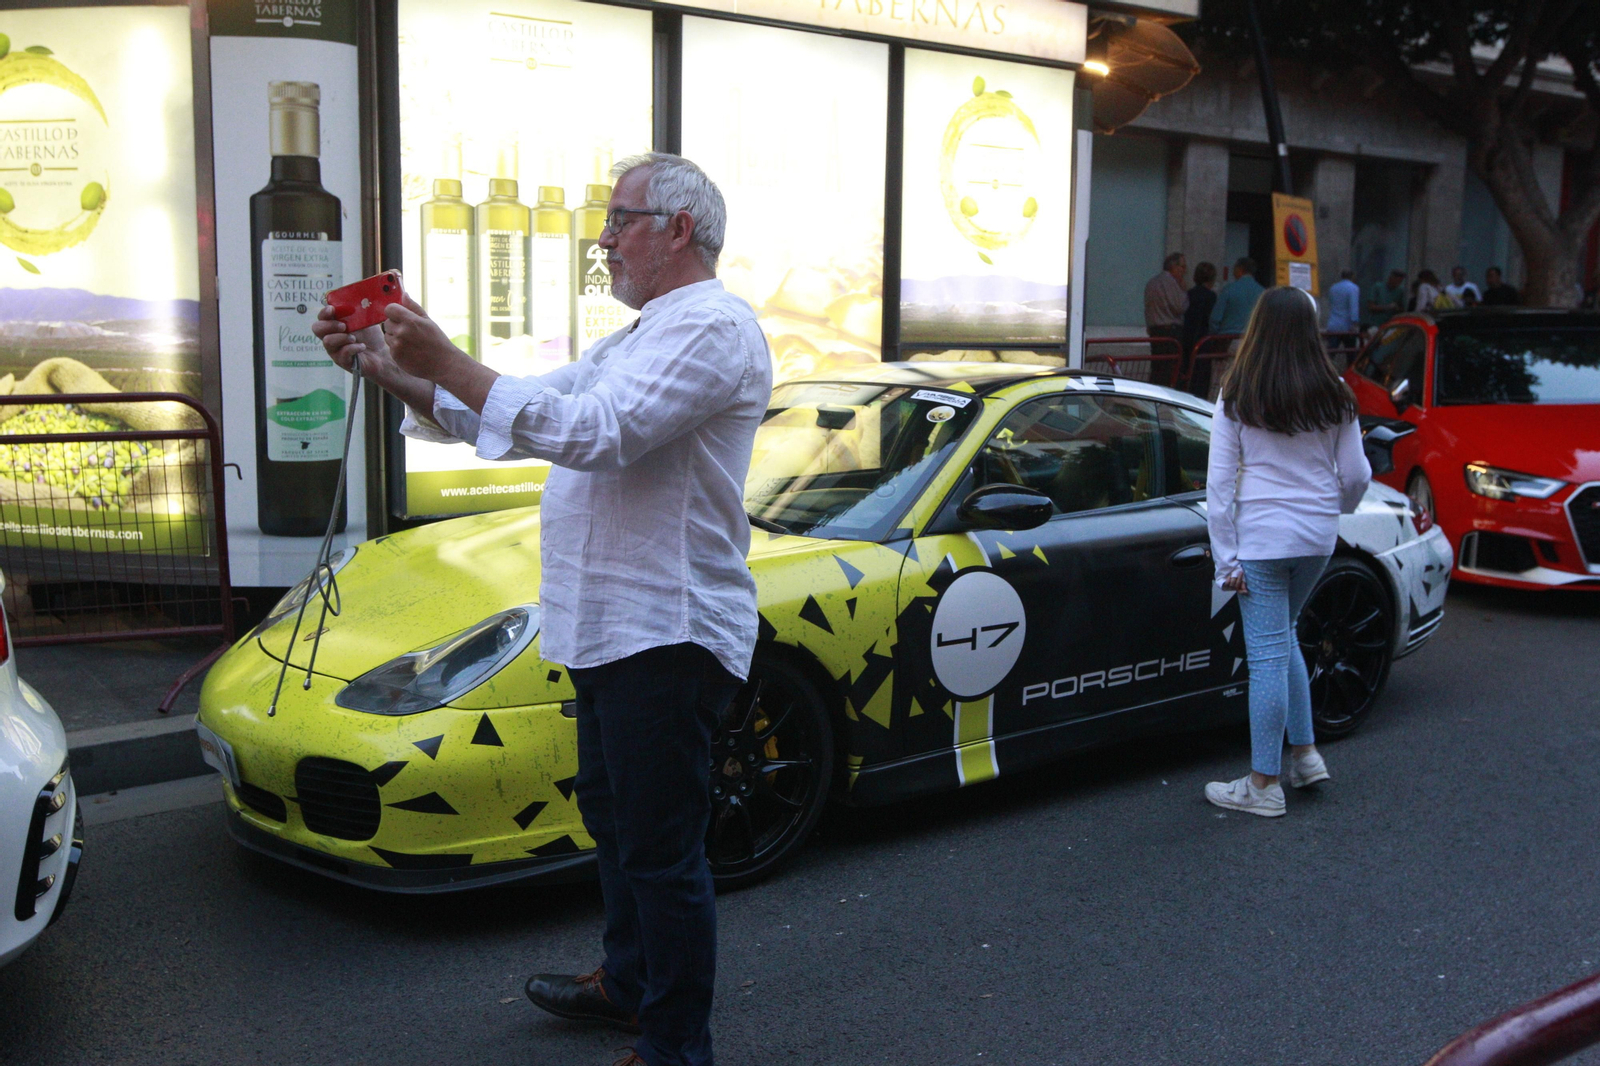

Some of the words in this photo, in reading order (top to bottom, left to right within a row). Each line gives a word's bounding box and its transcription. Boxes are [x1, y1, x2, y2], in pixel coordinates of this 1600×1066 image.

[255, 5, 322, 18] TABERNAS
[0, 127, 63, 141] ASTILLO
[0, 142, 79, 160] ABERNAS
[304, 254, 329, 262] EXTRA
[267, 279, 326, 291] CASTILLO
[585, 275, 613, 285] INDAL
[585, 284, 613, 297] OLI
[585, 317, 624, 327] EXTRA
[585, 328, 615, 339] VIRG
[937, 621, 1019, 651] 47
[1022, 649, 1211, 706] PORSCHE
